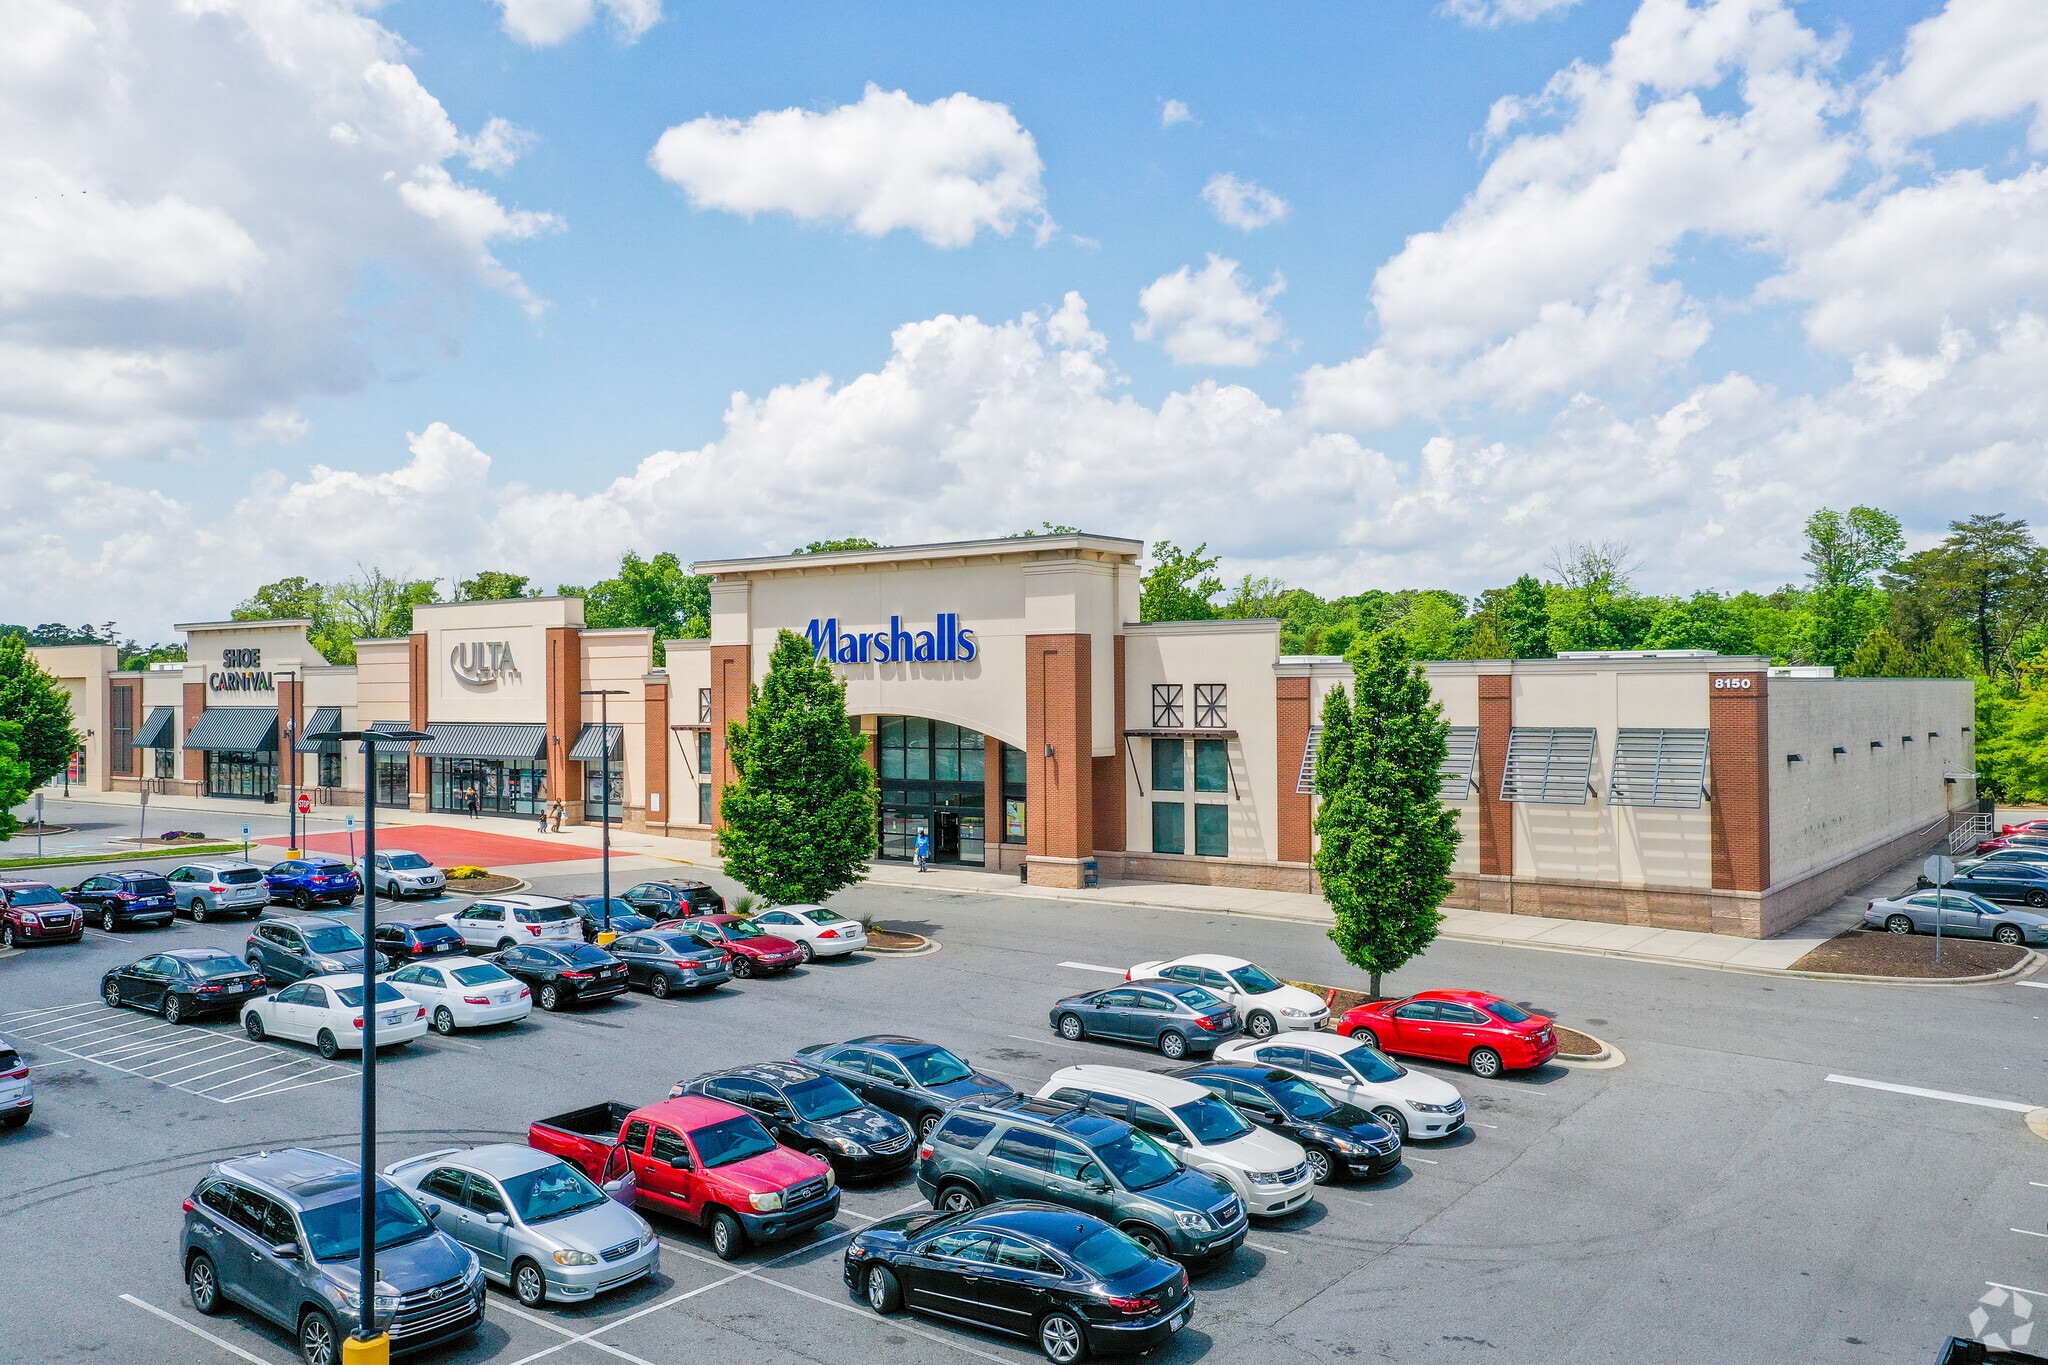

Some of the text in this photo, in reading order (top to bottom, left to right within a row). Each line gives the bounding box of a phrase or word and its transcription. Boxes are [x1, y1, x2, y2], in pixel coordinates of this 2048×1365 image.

[804, 613, 977, 664] Marshalls
[223, 648, 261, 668] SHOE
[459, 641, 518, 672] ULTA
[209, 671, 275, 691] CARNIVAL
[1714, 678, 1751, 689] 8150
[298, 800, 310, 808] STOP
